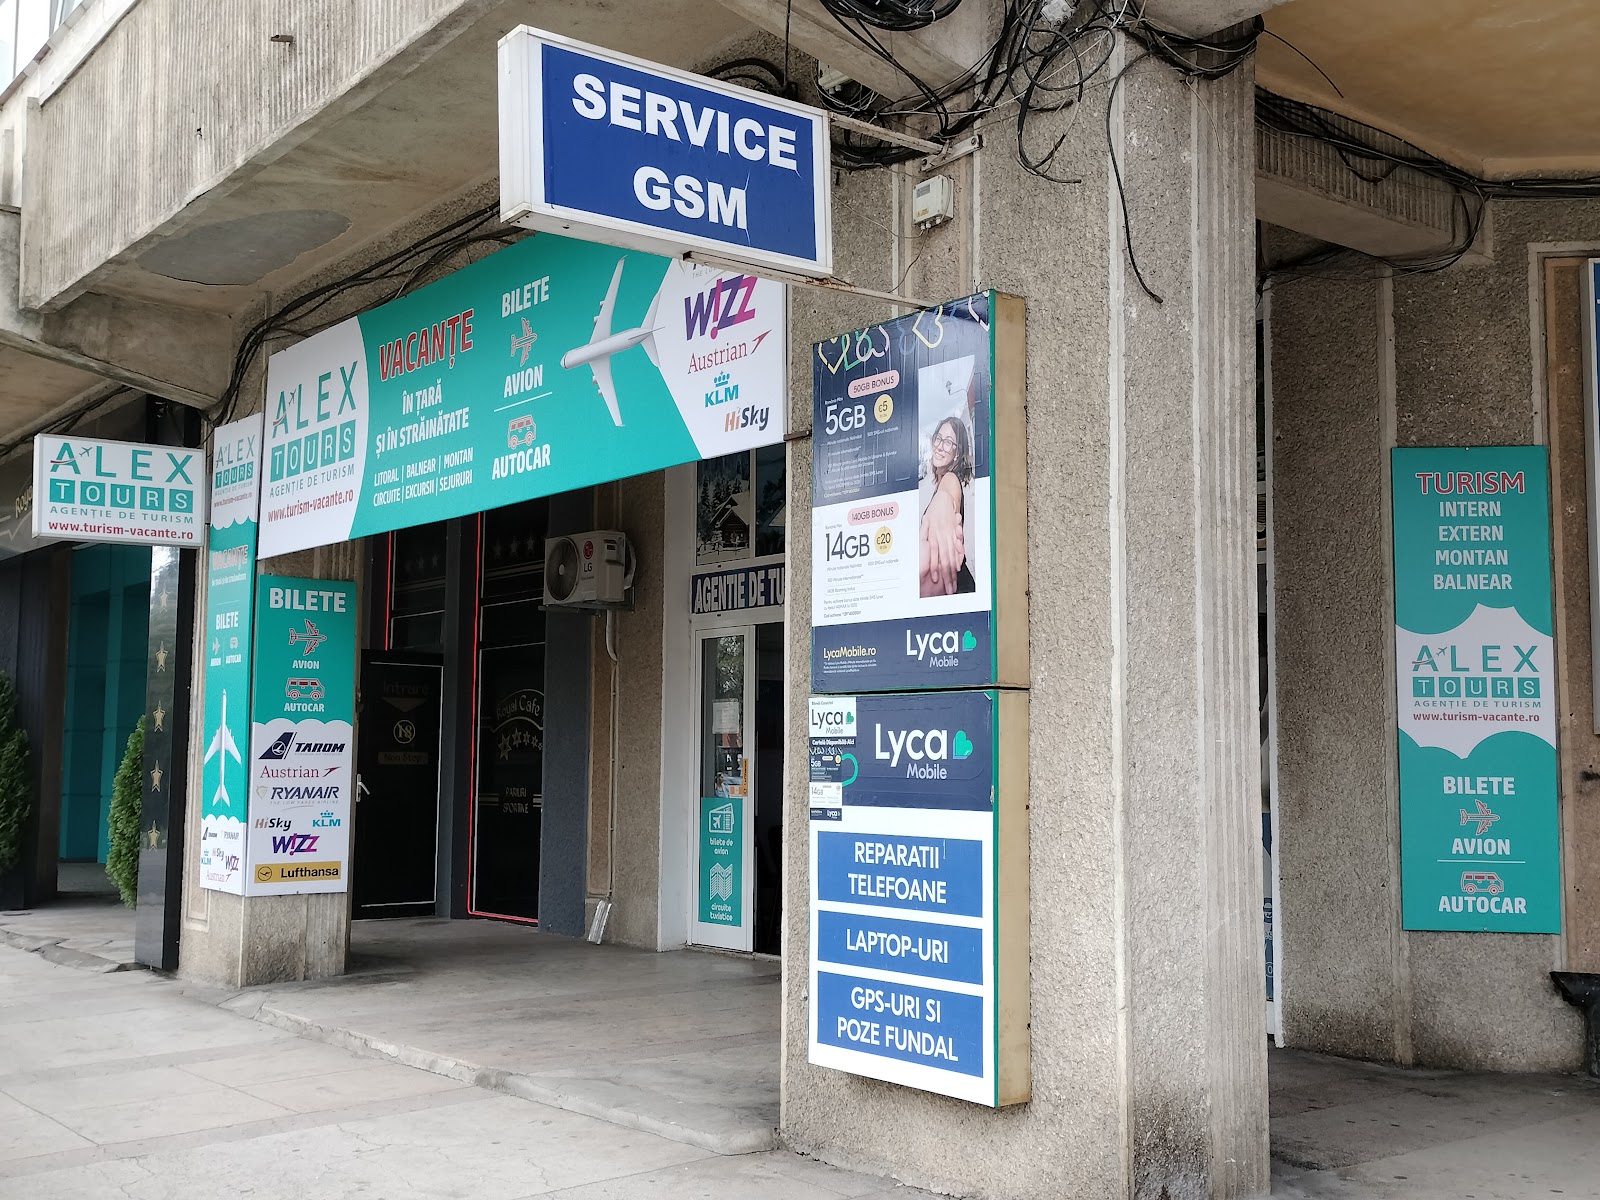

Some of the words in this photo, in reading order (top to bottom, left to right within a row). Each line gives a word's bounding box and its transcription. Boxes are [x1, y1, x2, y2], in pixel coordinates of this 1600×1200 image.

[572, 73, 797, 172] SERVICE
[633, 166, 747, 230] GSM
[501, 275, 549, 319] BILETE
[379, 308, 474, 382] VACANȚE
[687, 341, 747, 375] Austrian
[503, 364, 543, 398] AVION
[853, 382, 870, 394] 50GB
[871, 375, 895, 389] BONUS
[272, 360, 358, 439] ALEX
[402, 390, 413, 415] ÎN
[704, 384, 739, 408] KLM
[724, 404, 769, 432] HiSky
[825, 404, 866, 435] 5GB
[375, 435, 385, 459] ȘI
[387, 426, 398, 450] ÎN
[399, 407, 469, 447] STRĂINĂTATE
[216, 434, 255, 468] ALEX
[273, 427, 353, 476] TOURS
[492, 443, 551, 481] AUTOCAR
[50, 442, 193, 485] ALEX
[216, 464, 253, 486] TOURS
[374, 470, 399, 487] LITORAL
[406, 457, 436, 480] BALNEAR
[443, 447, 473, 469] MONTAN
[269, 478, 304, 498] AGENȚIE
[307, 474, 318, 488] DE
[321, 464, 355, 485] TURISM
[374, 490, 400, 507] CIRCUITE
[405, 478, 434, 500] EXCURSII
[439, 469, 473, 492] SEJURURI
[1415, 471, 1525, 495] TURISM
[55, 482, 188, 510] TOURS
[267, 489, 354, 523] www.turism-vacante.ro
[50, 506, 112, 519] AGENȚIE
[118, 511, 136, 520] DE
[142, 513, 193, 524] TURISM
[851, 510, 870, 522] 140GB
[871, 506, 894, 519] BONUS
[1439, 501, 1501, 517] INTERN
[48, 522, 193, 540] www.turism-vacante.ro
[1438, 525, 1504, 542] EXTERN
[825, 531, 870, 562] 14GB
[1435, 549, 1509, 566] MONTAN
[583, 562, 593, 573] LG
[694, 572, 746, 613] AGENTIE
[748, 569, 765, 607] DE
[1433, 573, 1513, 590] BALNEAR
[269, 587, 346, 613] BILETE
[215, 611, 239, 631] BILETE
[823, 645, 877, 661] LycaMobile.ro
[906, 629, 959, 660] Lyca
[292, 659, 320, 670] AVION
[929, 656, 959, 668] Mobile
[1412, 644, 1540, 673] ALEX
[1416, 678, 1536, 696] TOURS
[284, 702, 325, 712] AUTOCAR
[519, 694, 540, 717] Cafe
[1412, 711, 1540, 722] www.turism-vacante.ro
[1414, 700, 1467, 710] AGENȚIE
[1473, 700, 1489, 708] DE
[1493, 700, 1542, 708] TURISM
[811, 708, 844, 730] Lyca
[295, 742, 346, 753] TAROM
[875, 723, 948, 767] Lyca
[259, 765, 319, 779] Austrian
[906, 763, 947, 780] Mobile
[270, 786, 339, 800] RYANAIR
[1443, 776, 1516, 796] BILETE
[254, 817, 291, 832] HiSky
[312, 818, 341, 827] KLM
[726, 838, 733, 847] de
[1451, 838, 1511, 856] AVION
[854, 841, 939, 869] REPARATII
[281, 866, 339, 879] Lufthansa
[848, 873, 947, 904] TELEFOANE
[1438, 896, 1527, 914] AUTOCAR
[846, 928, 949, 964] LAPTOP-URI
[850, 986, 920, 1019] GPS-URI
[925, 999, 942, 1023] SI
[837, 1016, 880, 1047] POZE
[885, 1025, 959, 1062] FUNDAL
